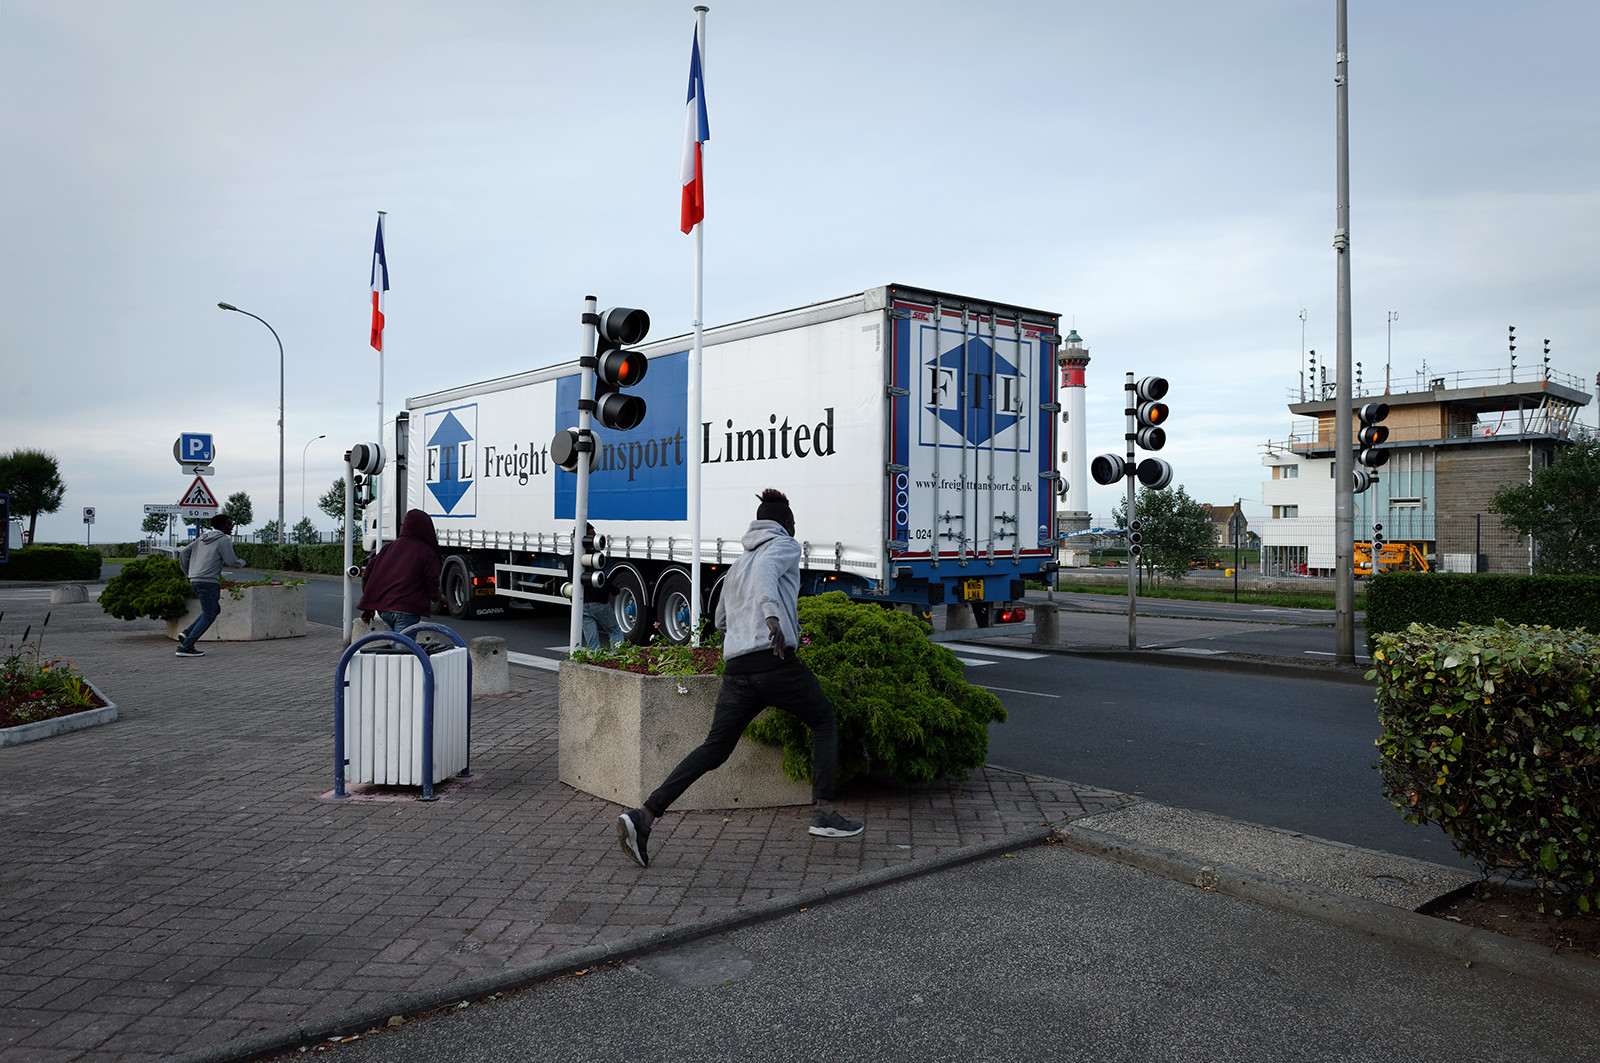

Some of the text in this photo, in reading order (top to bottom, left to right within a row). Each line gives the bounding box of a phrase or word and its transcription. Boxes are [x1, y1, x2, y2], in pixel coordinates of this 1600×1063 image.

[927, 367, 1023, 413] FTL
[190, 438, 204, 456] P
[484, 407, 836, 486] Freight nsport Limited
[426, 443, 474, 481] FTL
[897, 529, 932, 540] FTL 024
[476, 607, 504, 616] SCANIA
